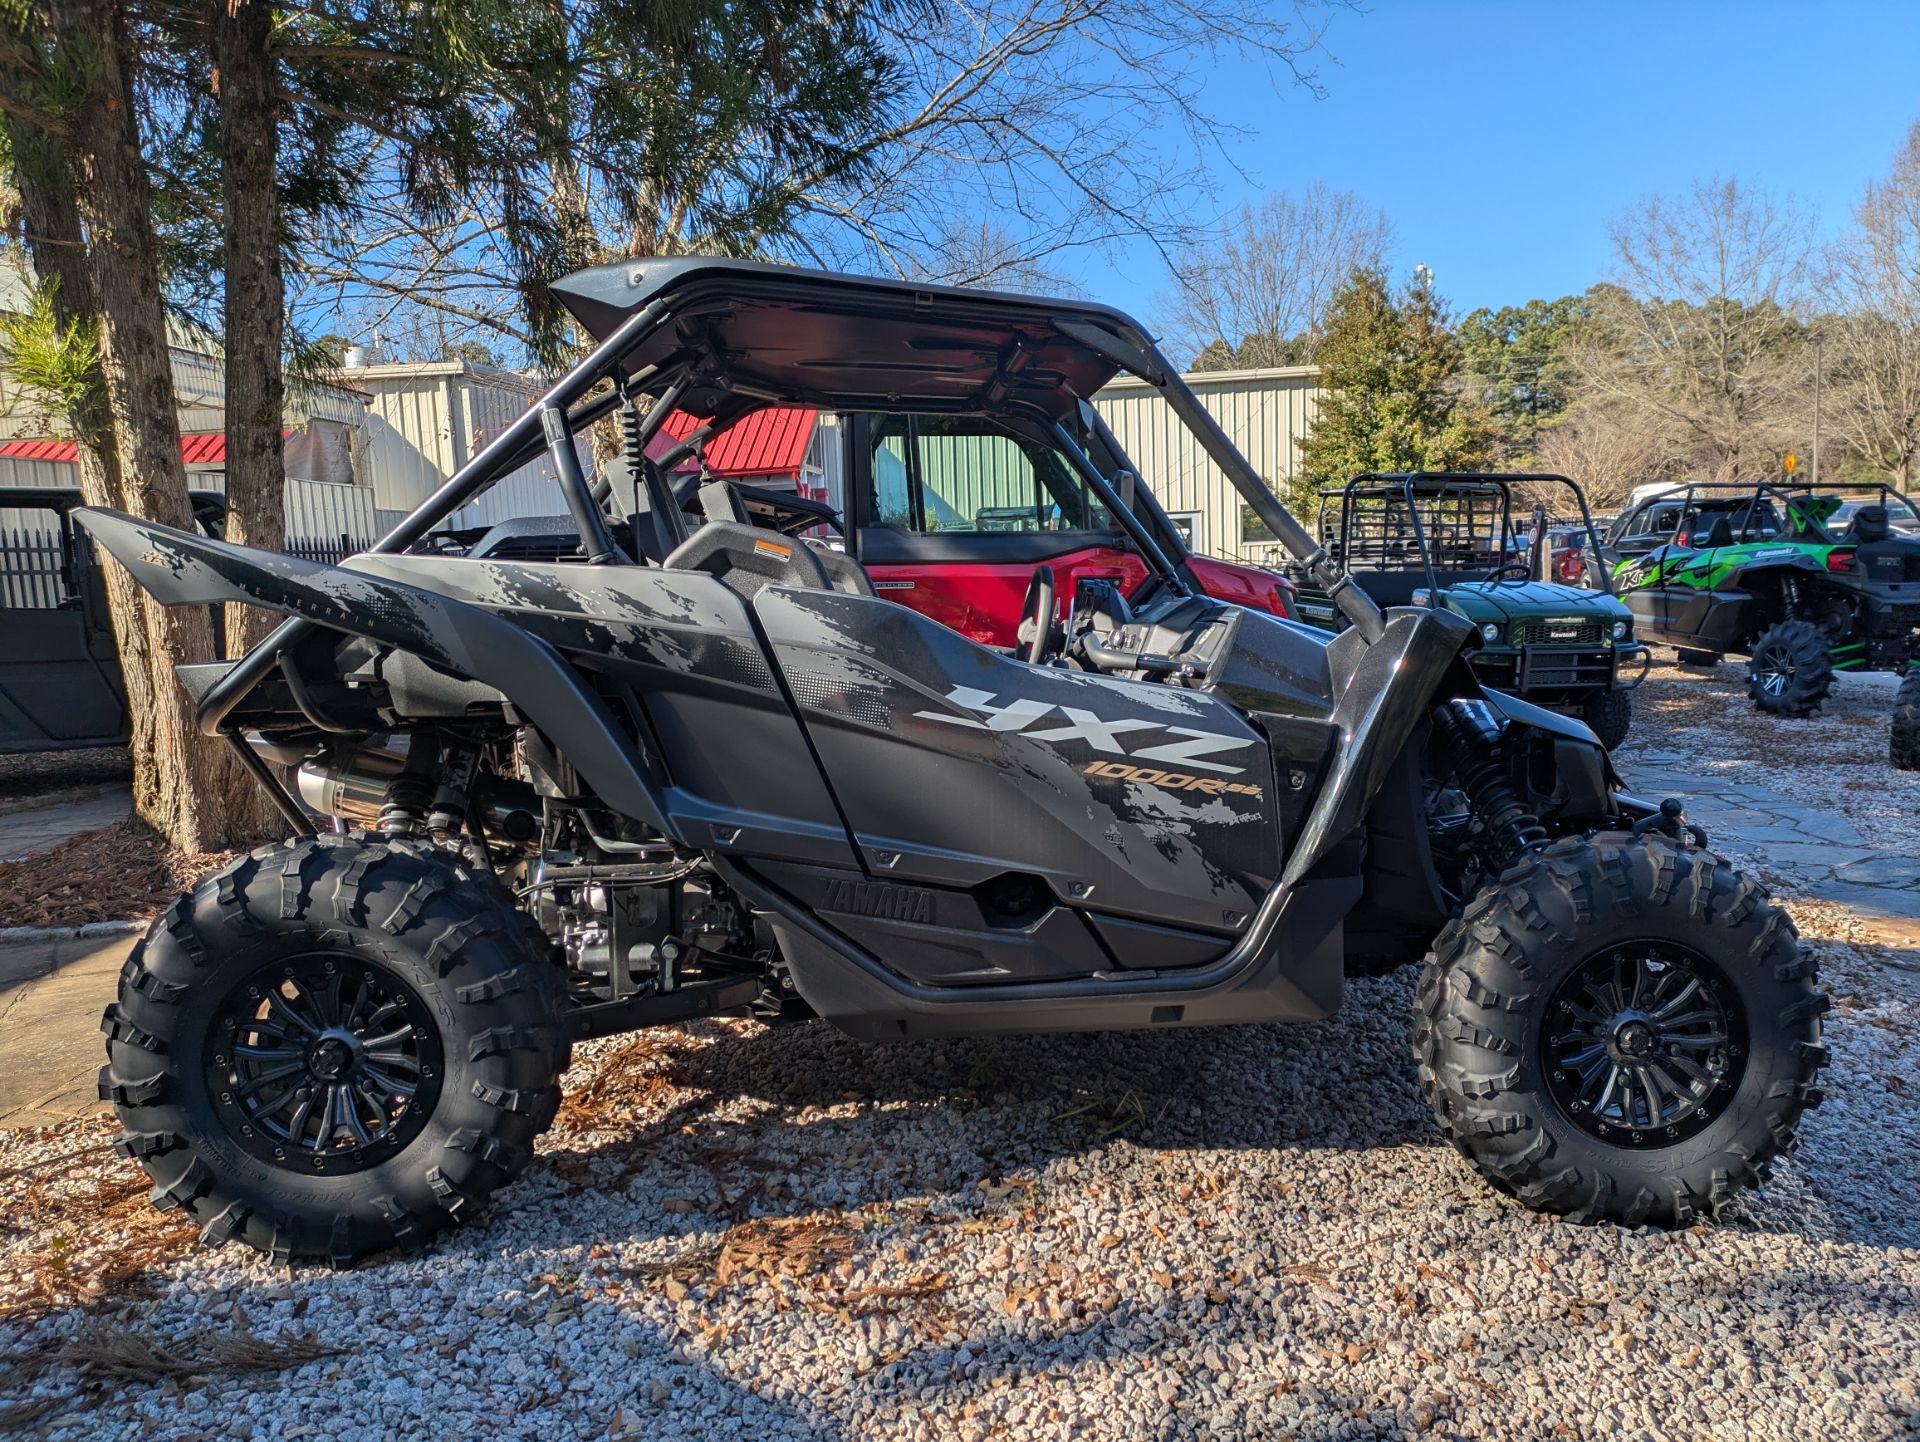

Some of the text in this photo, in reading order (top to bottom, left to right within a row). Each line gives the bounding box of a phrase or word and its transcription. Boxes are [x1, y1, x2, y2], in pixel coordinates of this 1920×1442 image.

[1755, 547, 1795, 558] Kawasaki
[282, 592, 375, 629] TERRAIN
[1550, 631, 1578, 639] Kawasaki
[912, 684, 1257, 775] YXZ
[820, 879, 936, 922] YAMAHA
